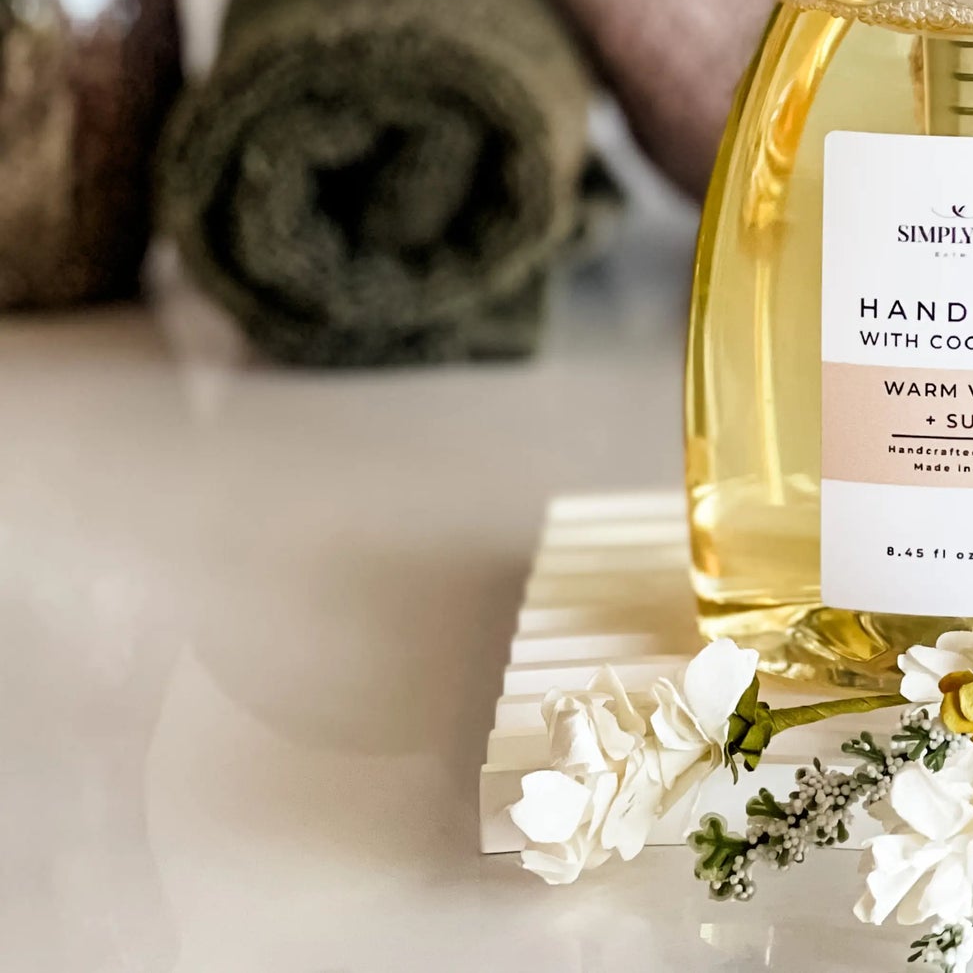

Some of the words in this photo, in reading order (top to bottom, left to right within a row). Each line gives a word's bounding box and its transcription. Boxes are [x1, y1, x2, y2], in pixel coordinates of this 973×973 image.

[860, 297, 967, 323] HAND
[860, 331, 918, 348] WITH
[884, 381, 956, 398] WARM
[913, 462, 951, 473] Made
[957, 463, 971, 473] in
[886, 545, 925, 559] 8.45
[934, 547, 946, 559] fl
